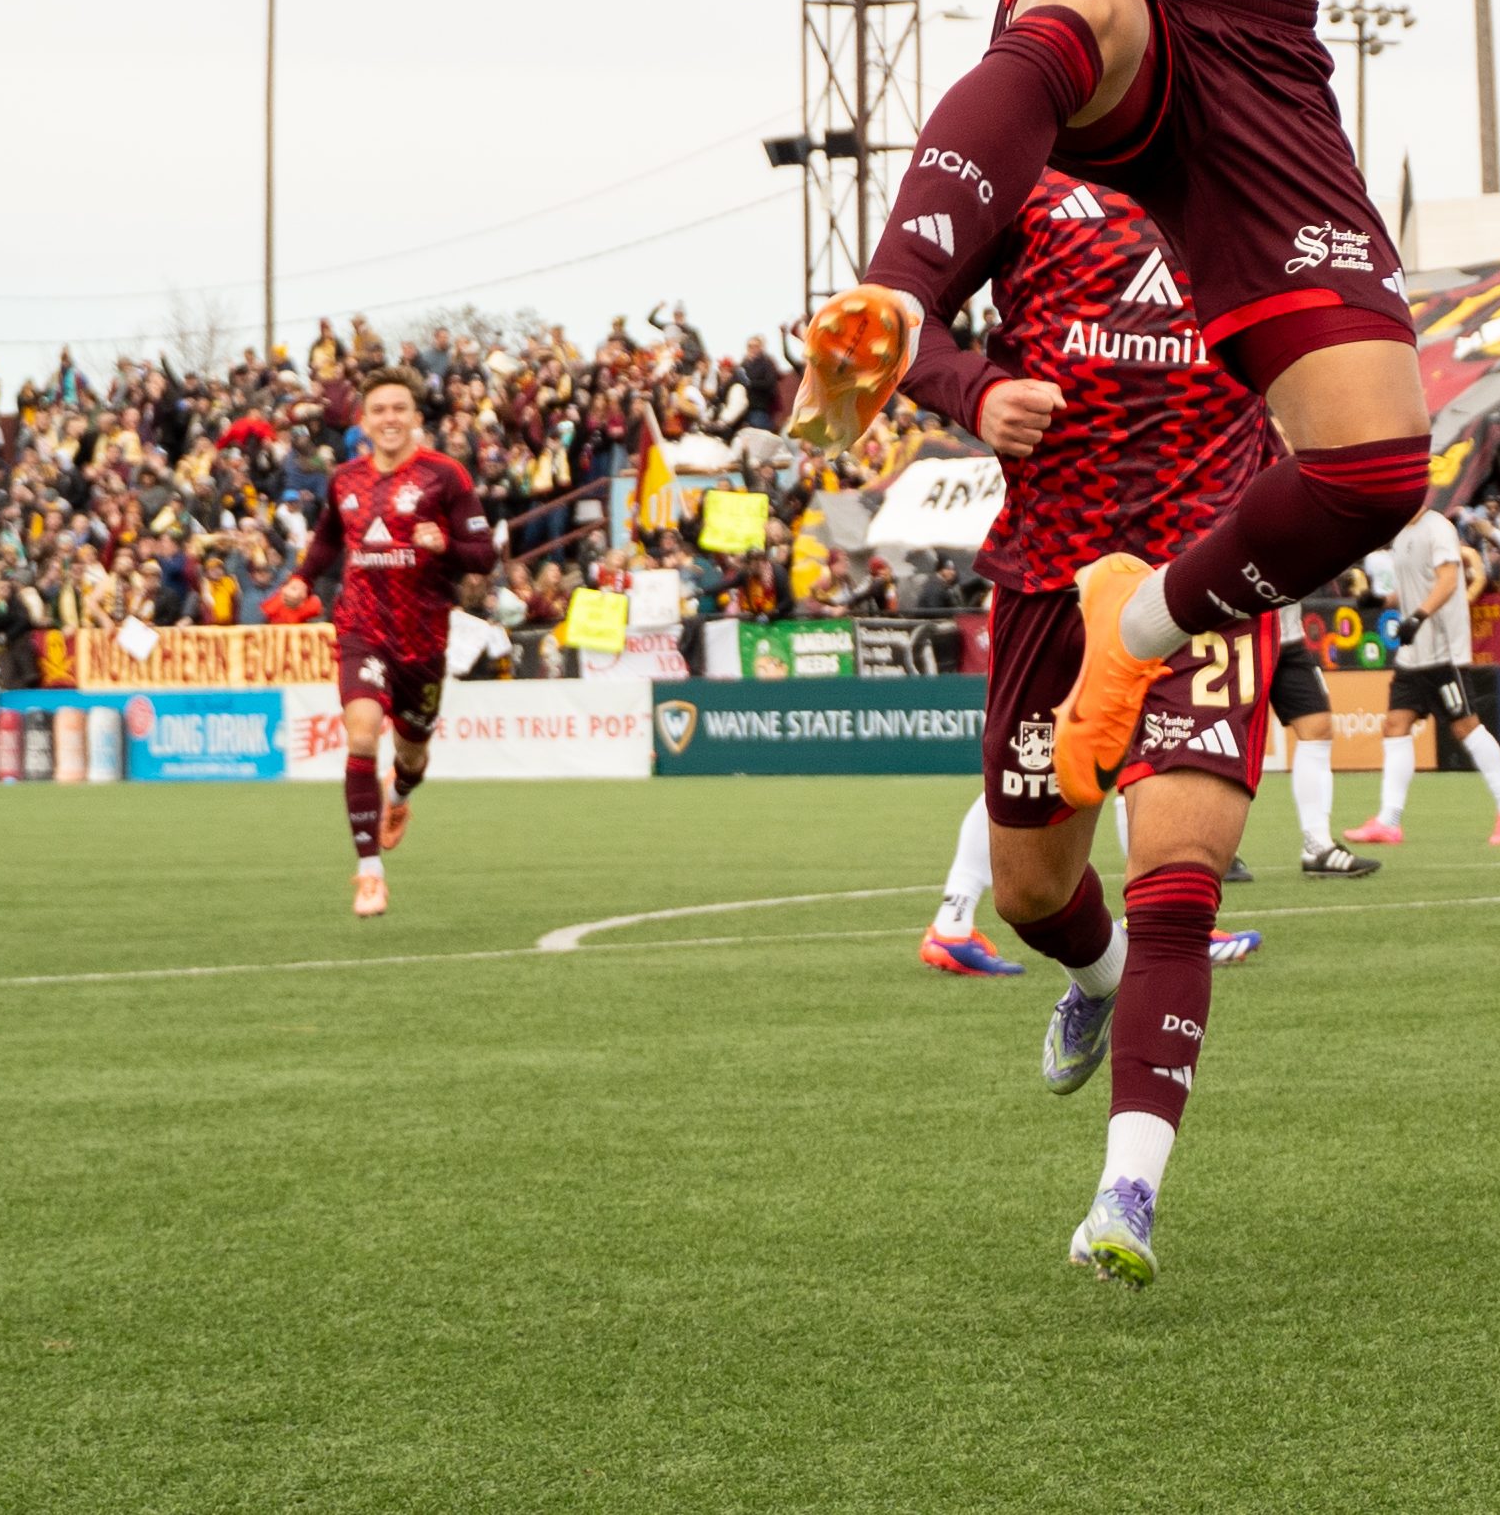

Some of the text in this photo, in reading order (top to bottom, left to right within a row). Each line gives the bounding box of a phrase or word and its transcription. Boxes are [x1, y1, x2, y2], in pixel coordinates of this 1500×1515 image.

[919, 147, 994, 205] DCFC
[1062, 320, 1210, 365] Alumni
[1240, 561, 1297, 604] DCF
[1192, 631, 1255, 707] 21
[152, 713, 202, 755] LONG
[205, 713, 270, 754] DRINK
[456, 716, 503, 738] ONE
[516, 716, 577, 738] TRUE
[703, 710, 783, 738] WAYNE
[787, 710, 852, 738] STATE
[1162, 1014, 1204, 1049] DCF
